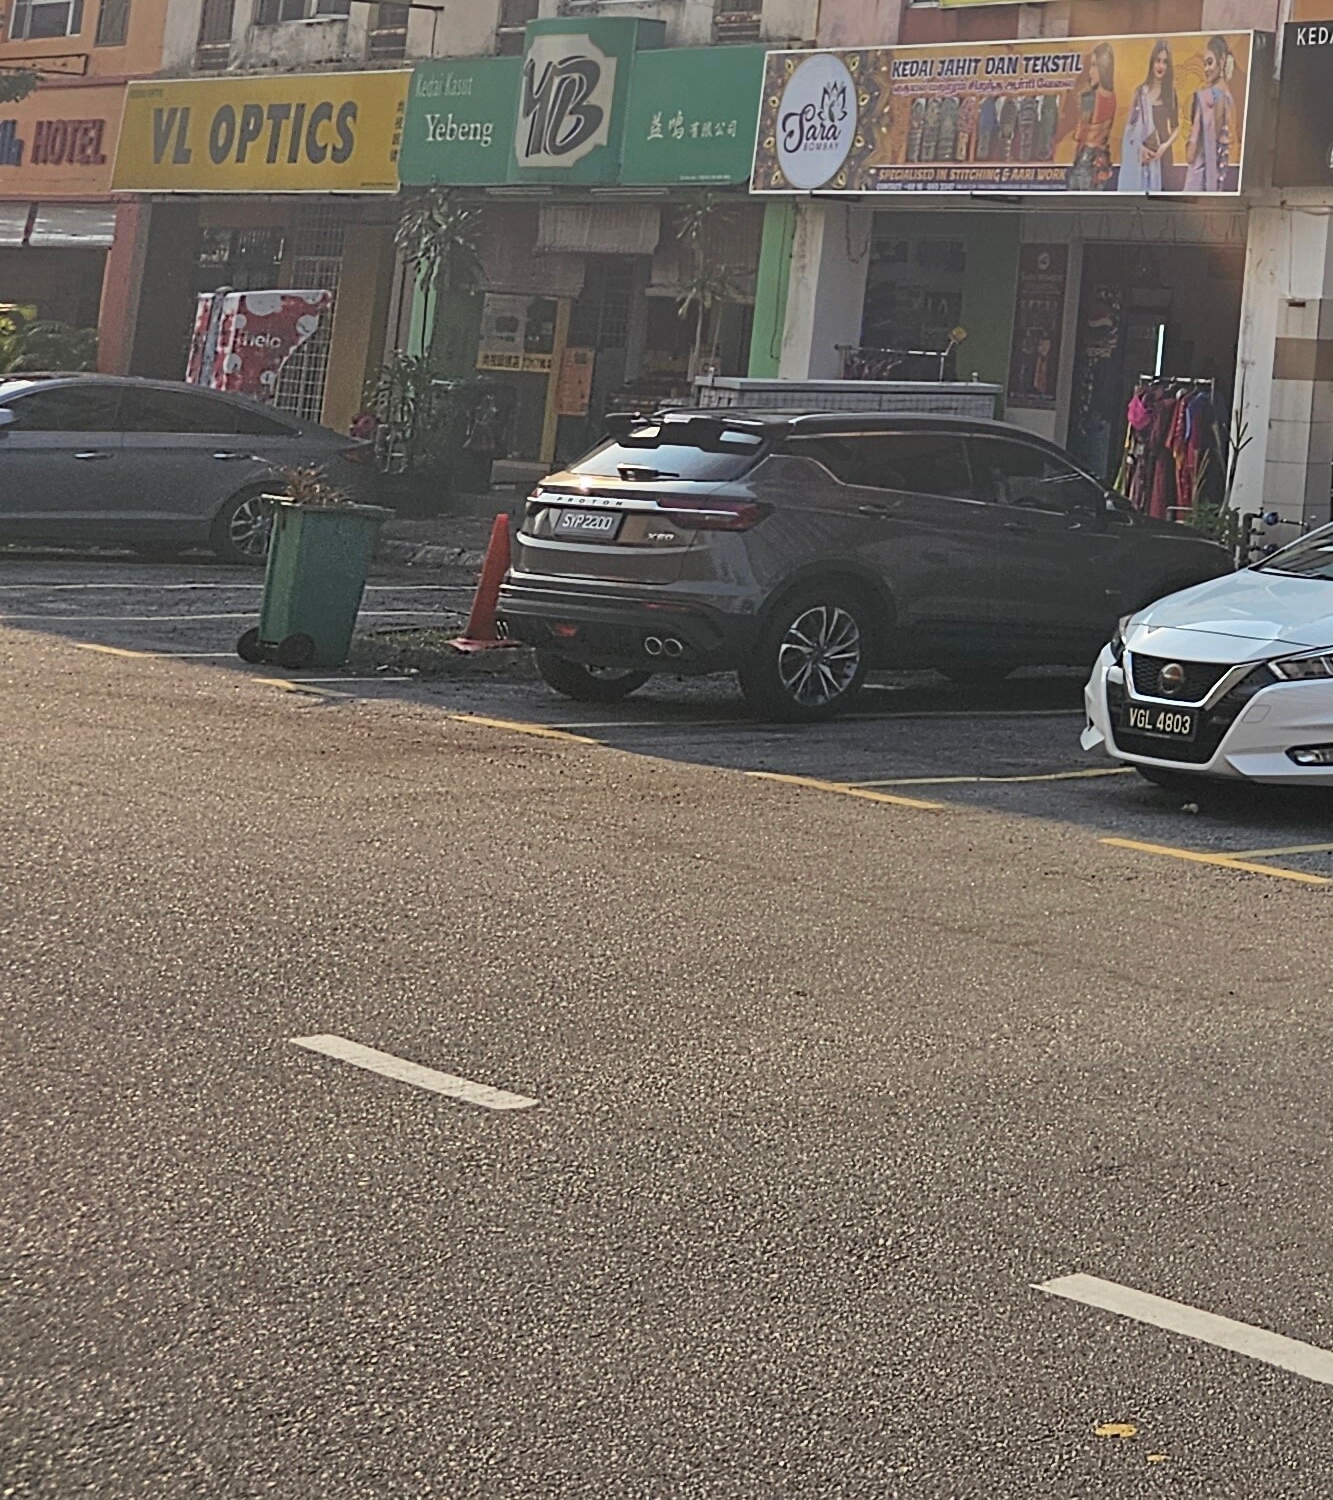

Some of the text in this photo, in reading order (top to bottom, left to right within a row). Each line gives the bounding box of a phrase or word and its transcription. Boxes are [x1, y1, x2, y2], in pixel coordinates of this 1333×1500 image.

[891, 53, 1083, 78] KEDAI JAHIT DAN TEKSTIL
[523, 54, 605, 158] YB
[29, 118, 107, 166] HOTEL
[152, 106, 193, 165] VL
[208, 101, 359, 165] OPTICS
[424, 113, 494, 147] Yebeng
[781, 103, 842, 154] Sara
[802, 140, 841, 152] BOMBAY
[878, 168, 935, 181] SPECIALISED
[936, 168, 947, 181] IN
[949, 168, 1000, 182] STITCHING
[1011, 168, 1034, 180] AARI
[1036, 168, 1067, 180] WORK
[556, 496, 624, 507] PROTON
[1129, 707, 1191, 735] VGL 4803
